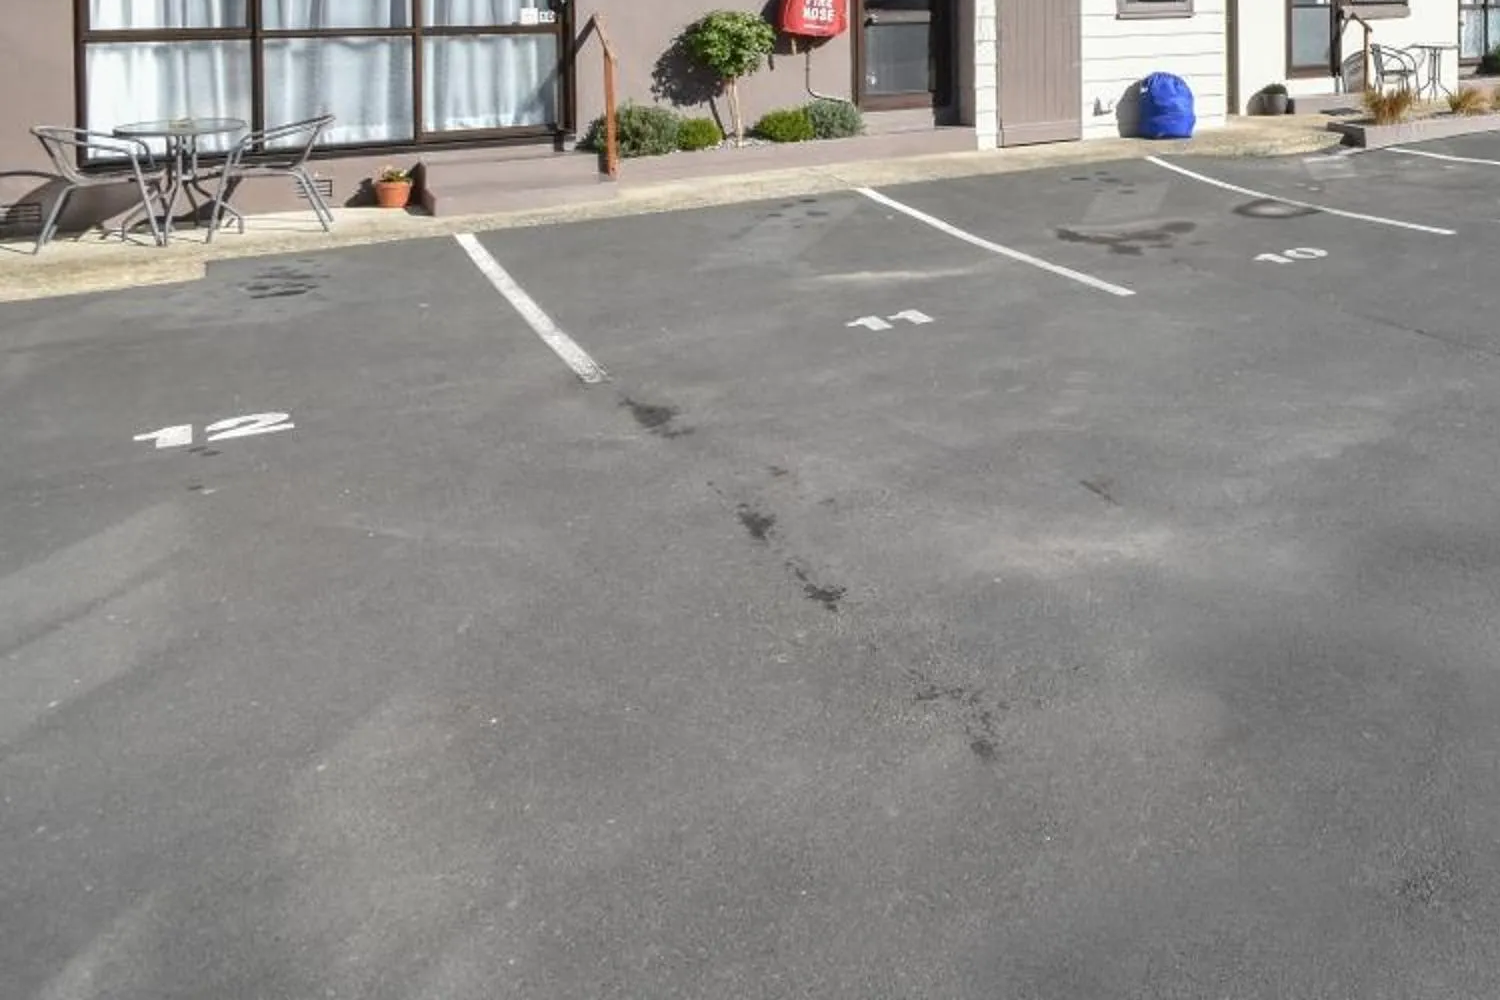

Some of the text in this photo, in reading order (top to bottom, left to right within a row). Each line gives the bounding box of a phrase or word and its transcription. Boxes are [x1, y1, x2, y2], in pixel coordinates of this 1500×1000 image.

[802, 7, 835, 22] HOSE
[1253, 247, 1328, 264] 10
[846, 309, 934, 331] 11
[133, 412, 295, 448] 12
